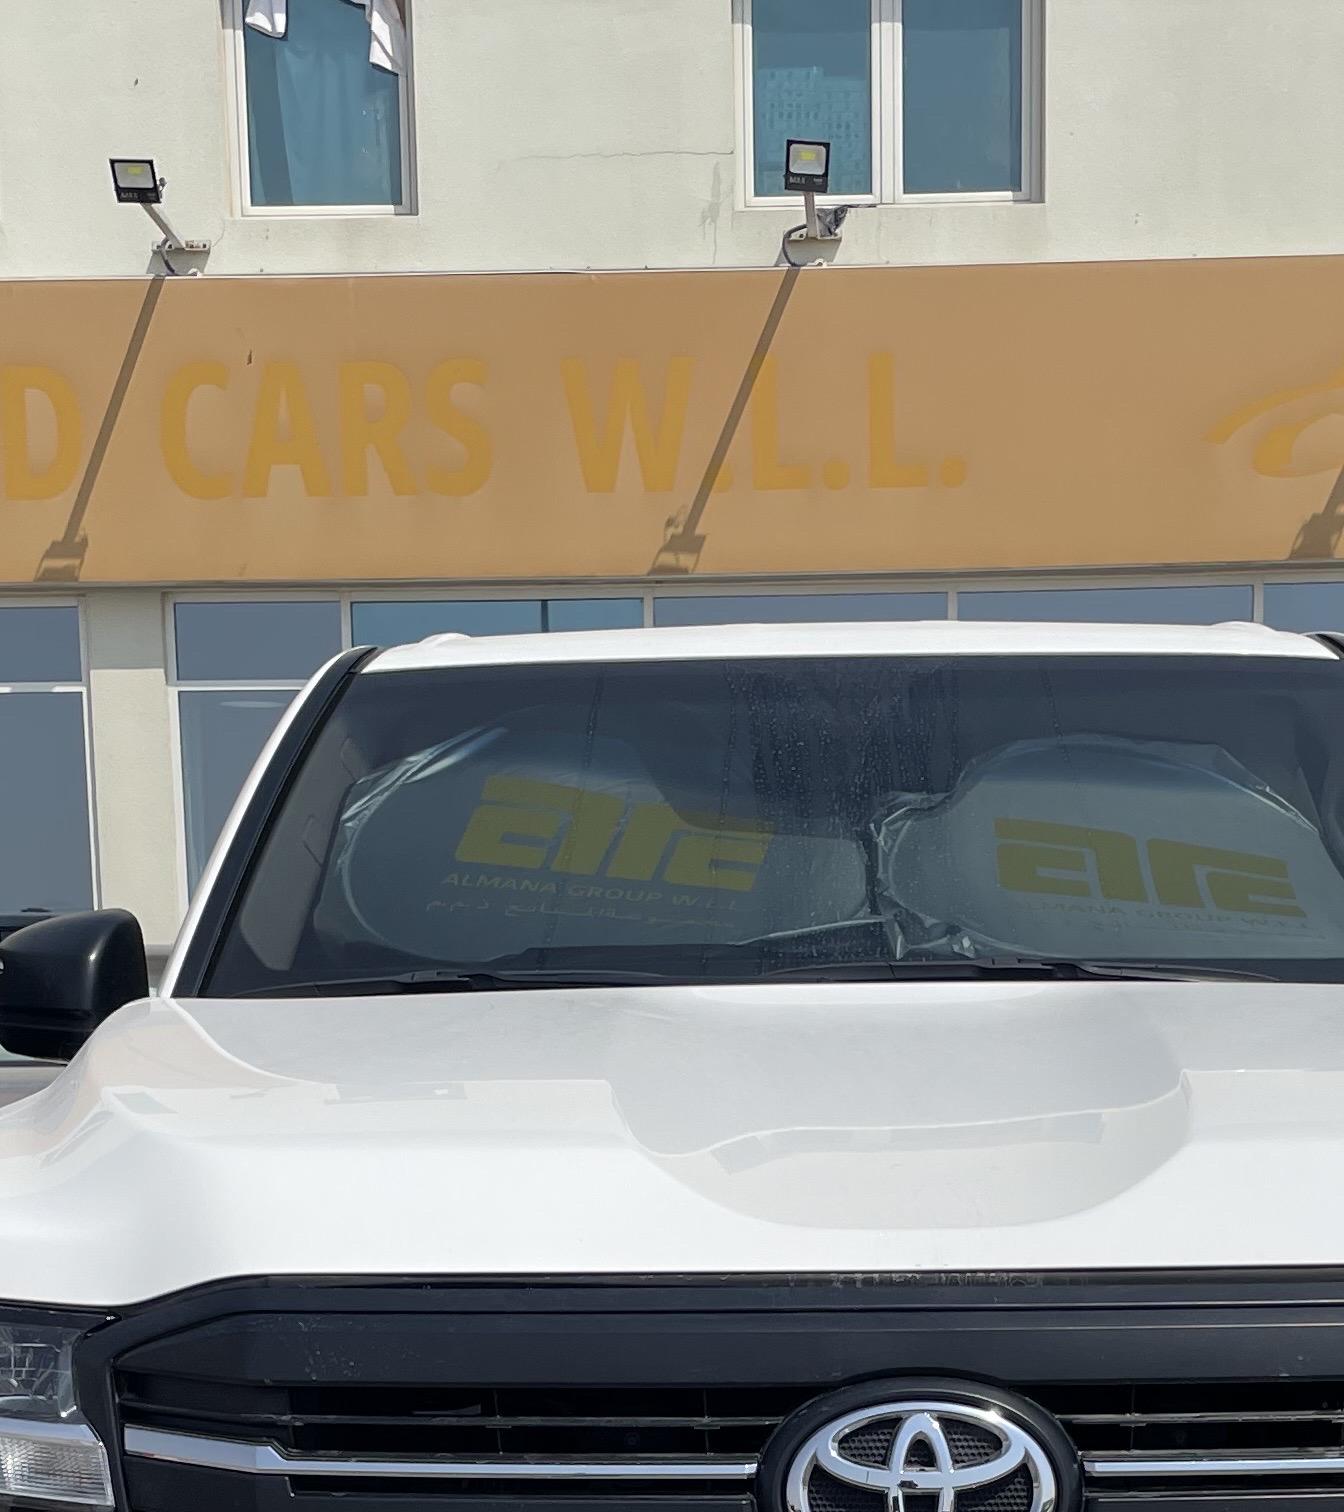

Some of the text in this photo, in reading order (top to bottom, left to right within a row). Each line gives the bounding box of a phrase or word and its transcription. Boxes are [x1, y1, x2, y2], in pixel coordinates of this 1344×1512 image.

[160, 357, 493, 501] CARS
[562, 352, 967, 494] W.L.L.
[441, 873, 557, 894] ALMANA
[568, 884, 664, 902] GROUP
